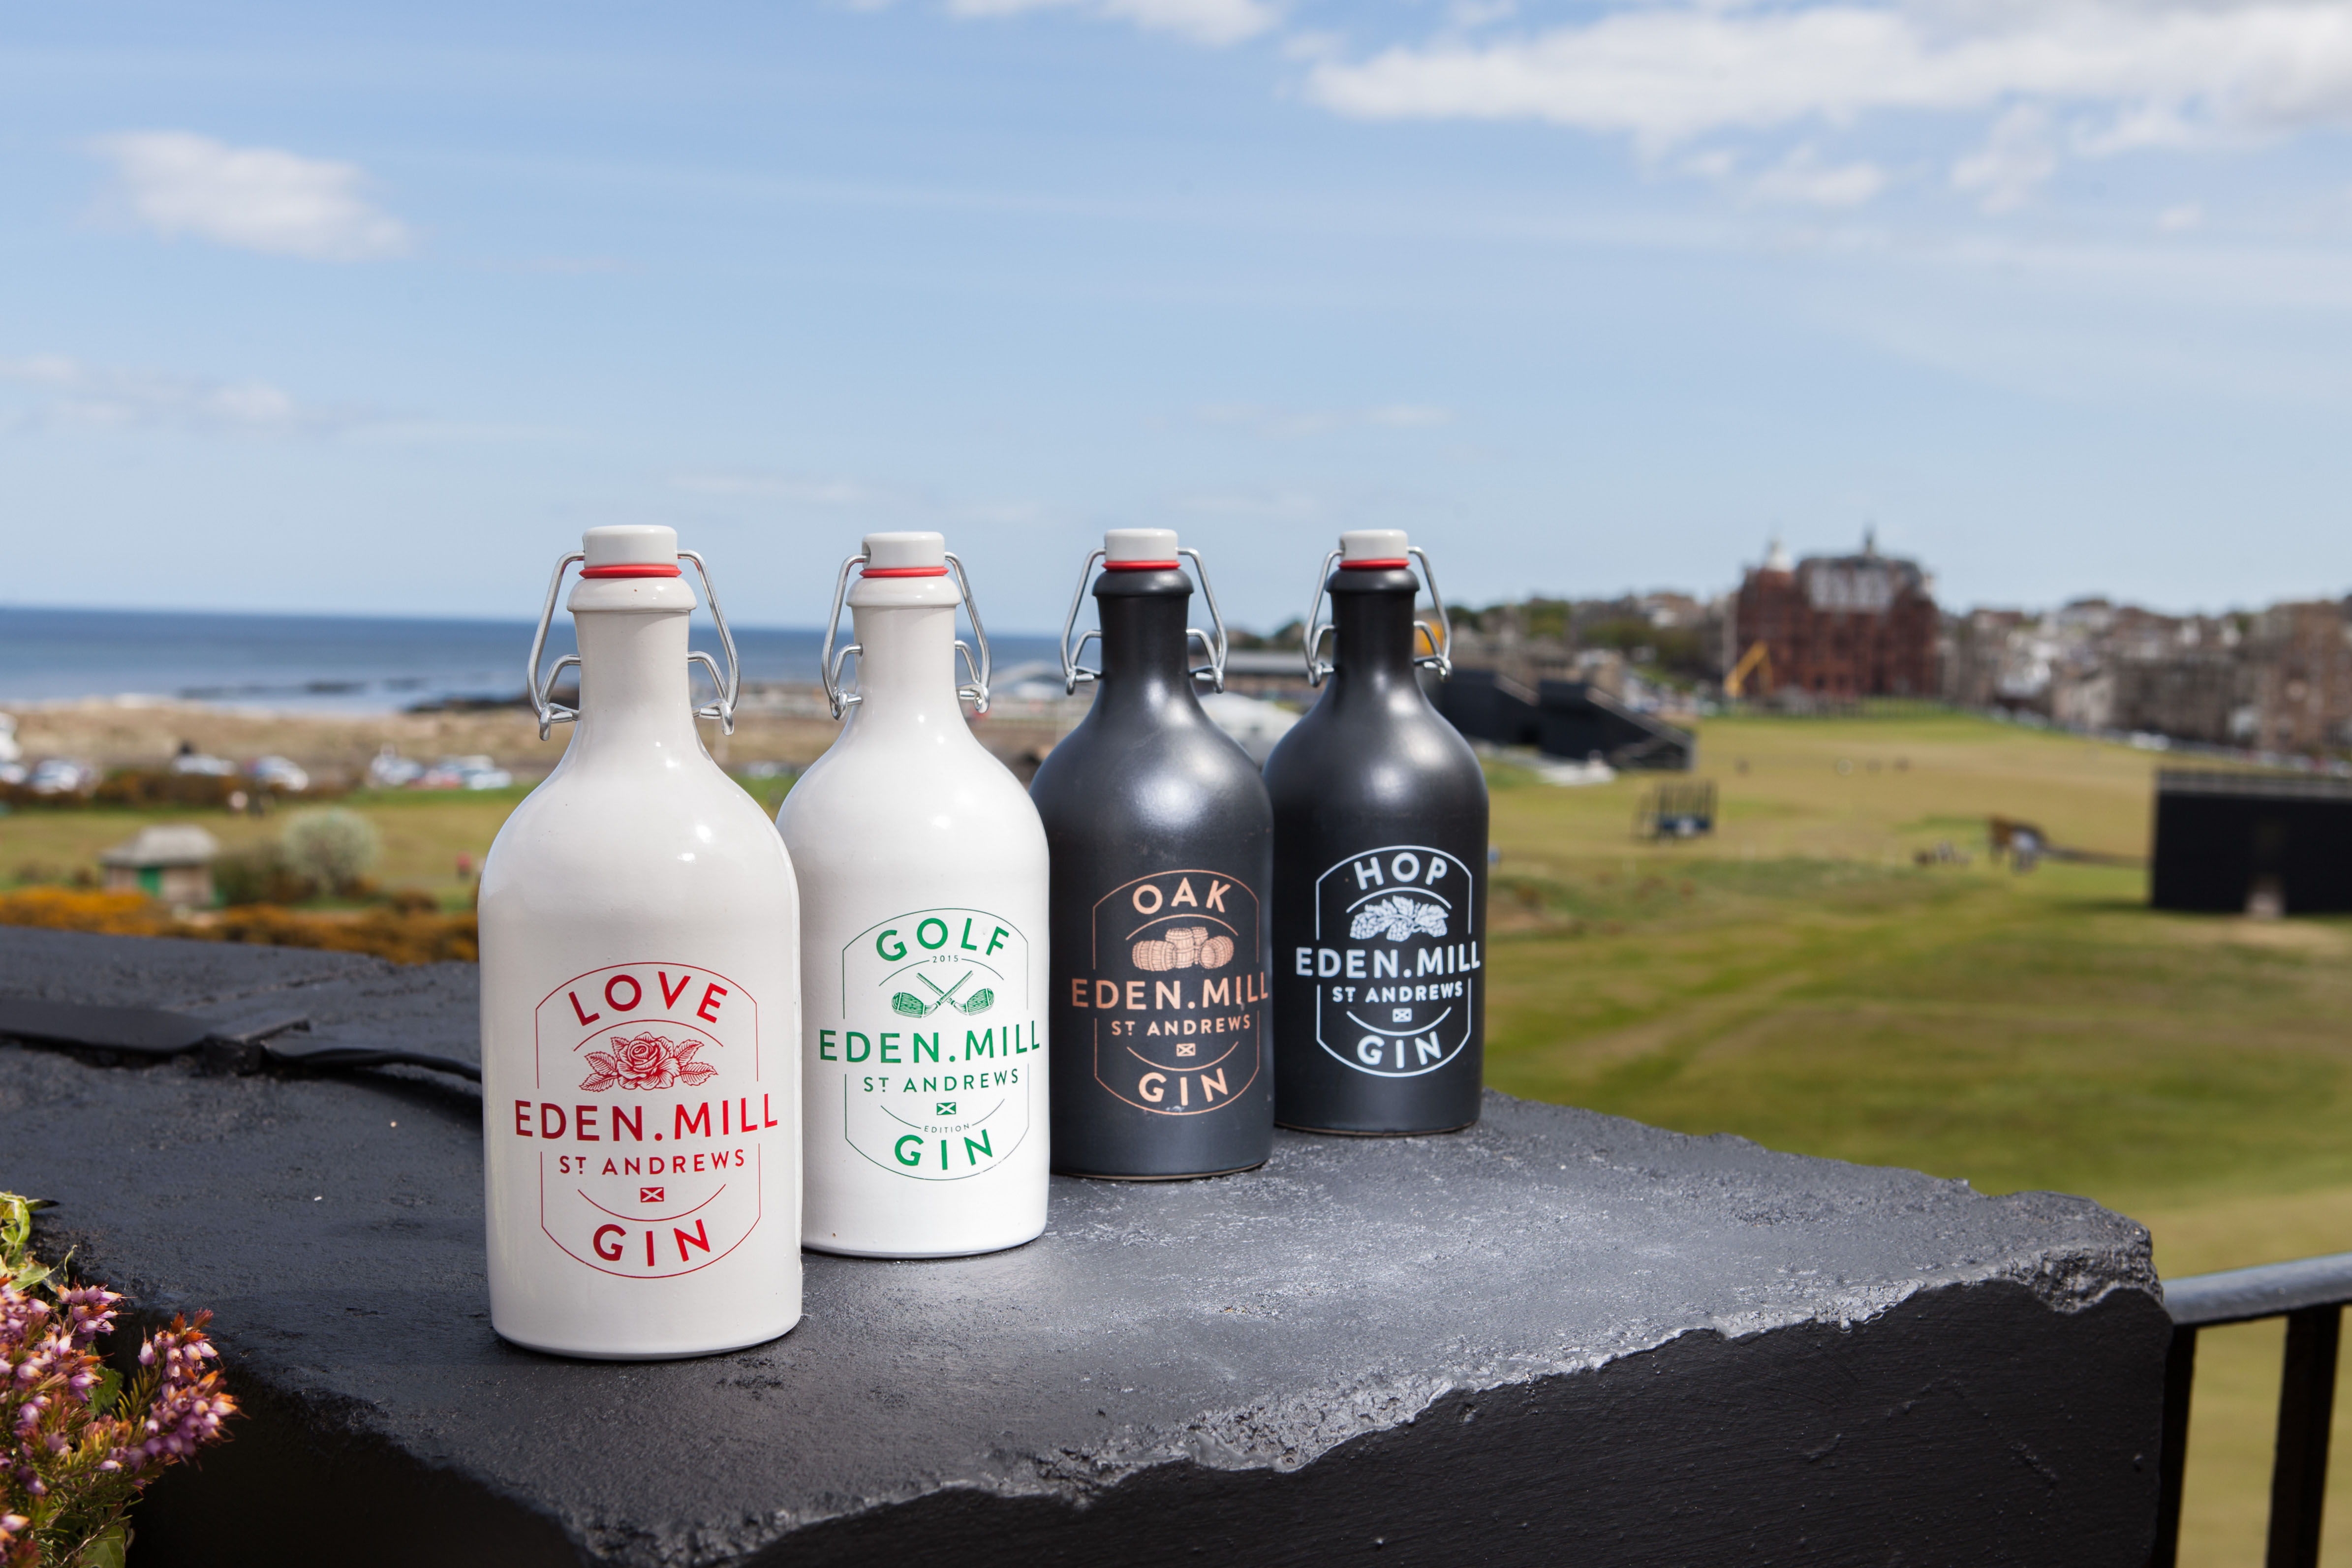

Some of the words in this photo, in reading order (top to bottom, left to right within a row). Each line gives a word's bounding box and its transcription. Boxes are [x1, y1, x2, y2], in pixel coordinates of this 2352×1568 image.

[1354, 852, 1448, 890] HOP
[1133, 877, 1231, 915] OAK
[876, 918, 1009, 961] GOLF
[1296, 941, 1481, 978] EDEN.MILL
[568, 971, 728, 1026] LOVE
[1072, 971, 1268, 1010] EDEN.MILL
[1365, 981, 1462, 1003] ANDREWS
[820, 1020, 1040, 1064] EDEN.MILL
[1147, 1014, 1250, 1036] ANDREWS
[1357, 1031, 1441, 1069] GIN
[903, 1069, 1018, 1093] ANDREWS
[1139, 1068, 1228, 1106] GIN
[515, 1093, 778, 1141] EDEN.MILL
[925, 1123, 969, 1133] EDITION
[602, 1149, 744, 1175] ANDREWS
[895, 1129, 992, 1170] GIN
[593, 1219, 711, 1266] GIN
